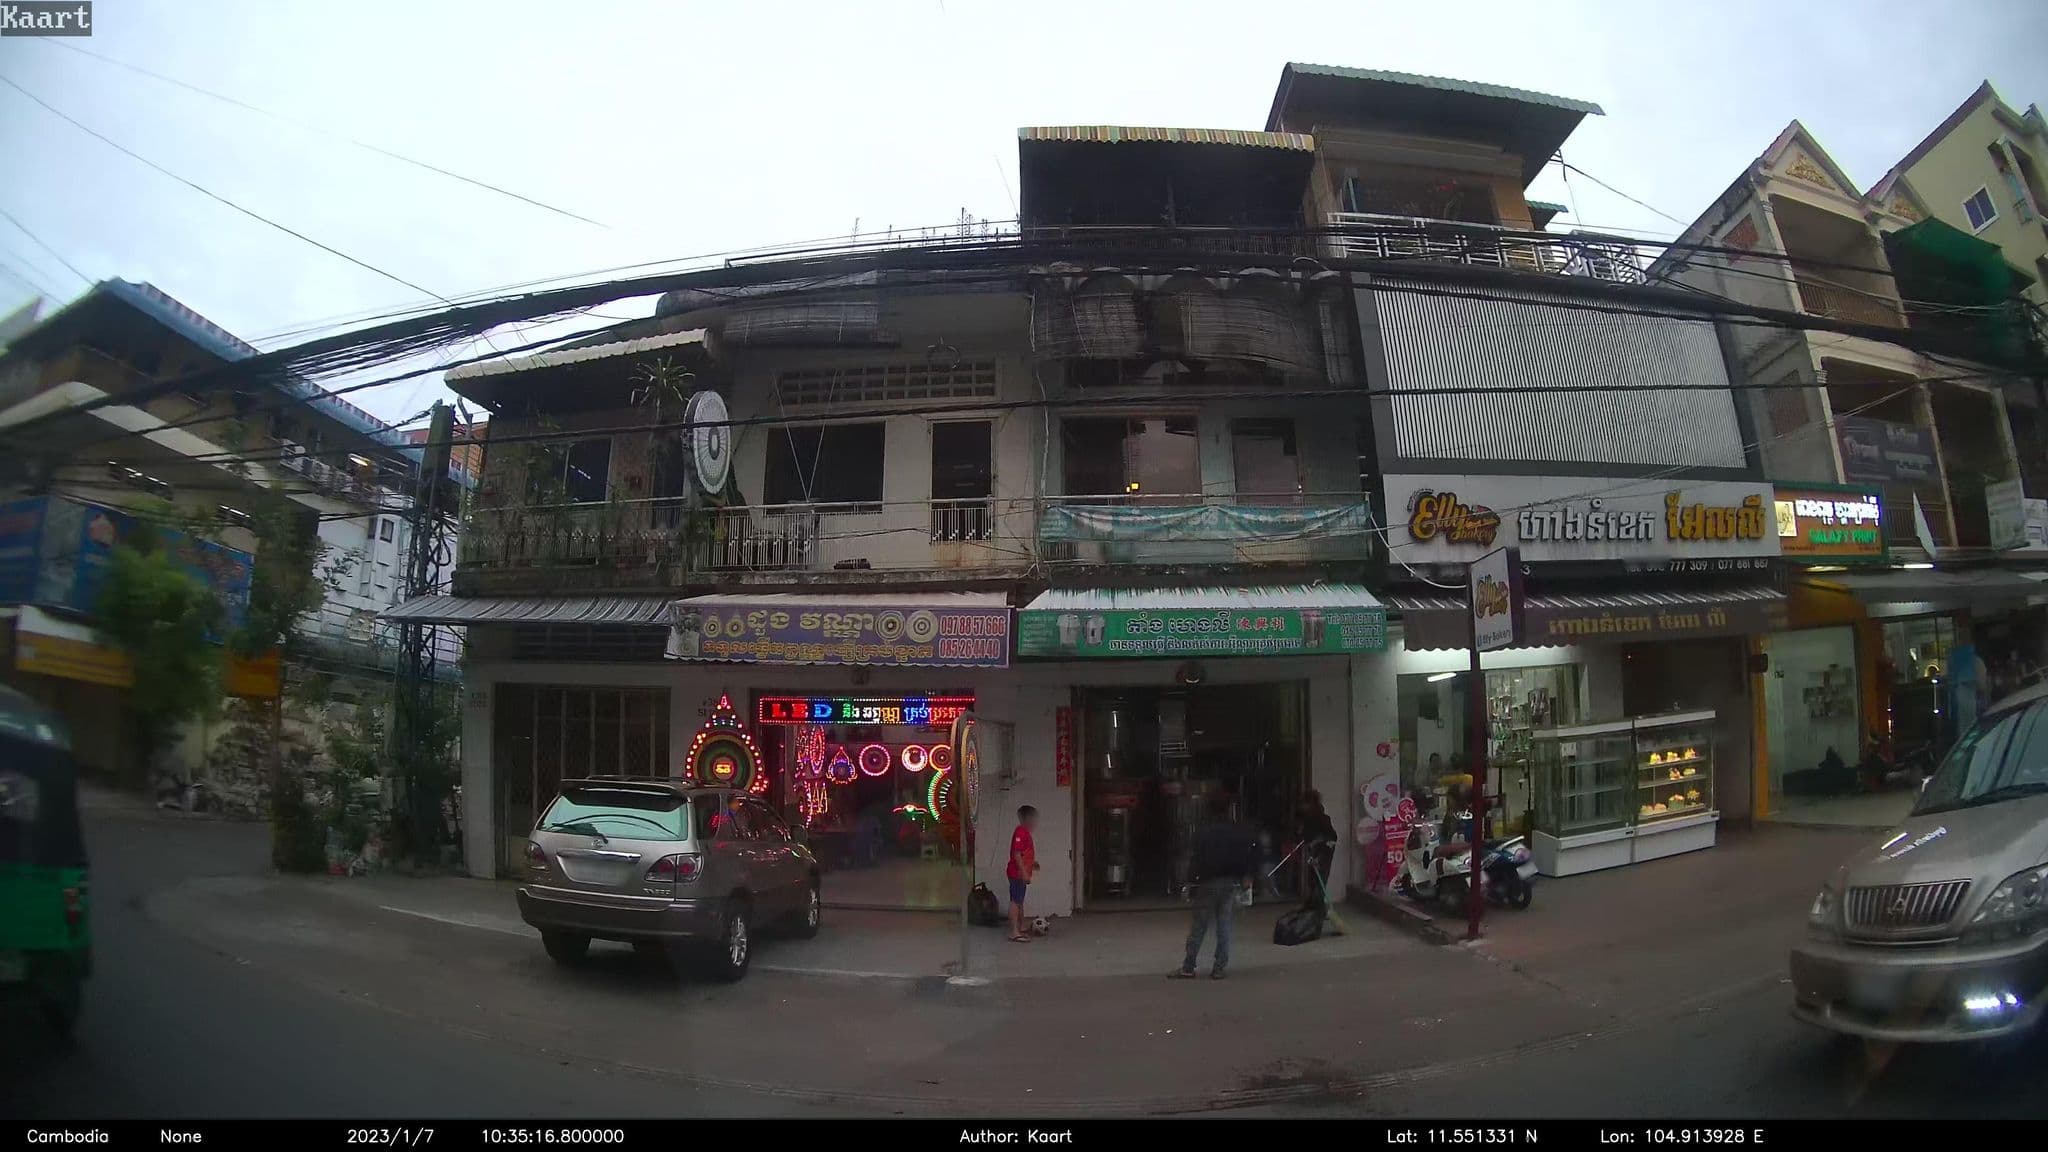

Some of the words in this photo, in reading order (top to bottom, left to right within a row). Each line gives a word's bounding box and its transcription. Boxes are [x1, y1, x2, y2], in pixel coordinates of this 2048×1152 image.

[1519, 498, 1656, 541] ហាងនំខេក
[1670, 561, 1686, 572] 777
[1690, 560, 1708, 572] 309
[1718, 559, 1733, 570] 077
[771, 703, 833, 718] LED
